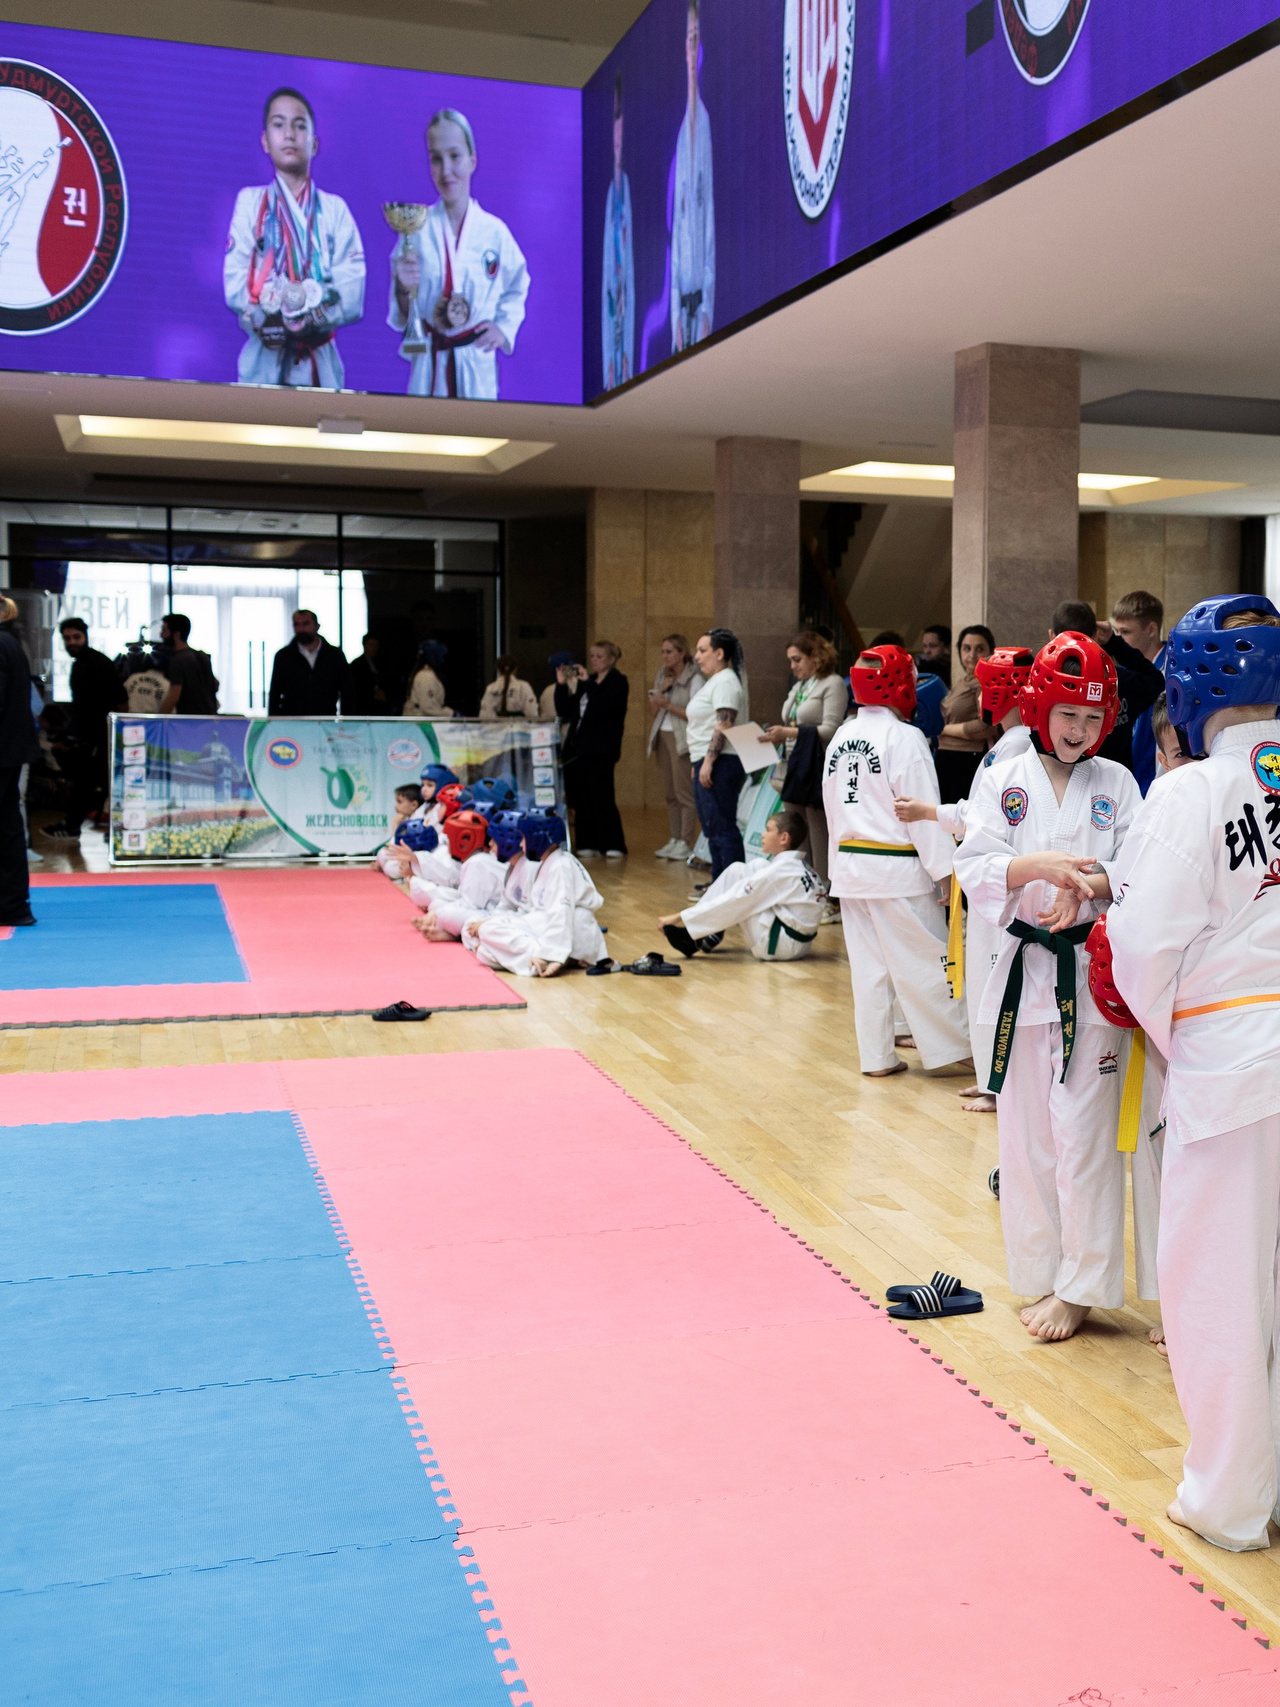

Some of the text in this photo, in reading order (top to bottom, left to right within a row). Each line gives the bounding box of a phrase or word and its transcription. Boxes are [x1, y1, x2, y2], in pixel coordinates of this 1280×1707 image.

[49, 183, 123, 321] Республики
[41, 590, 129, 629] УЗЕЙ
[828, 739, 882, 777] TAEKWON-DO
[305, 813, 389, 828] ЖЕЛЕЗНОВОДСК
[994, 1010, 1014, 1074] TAEKWON-DO
